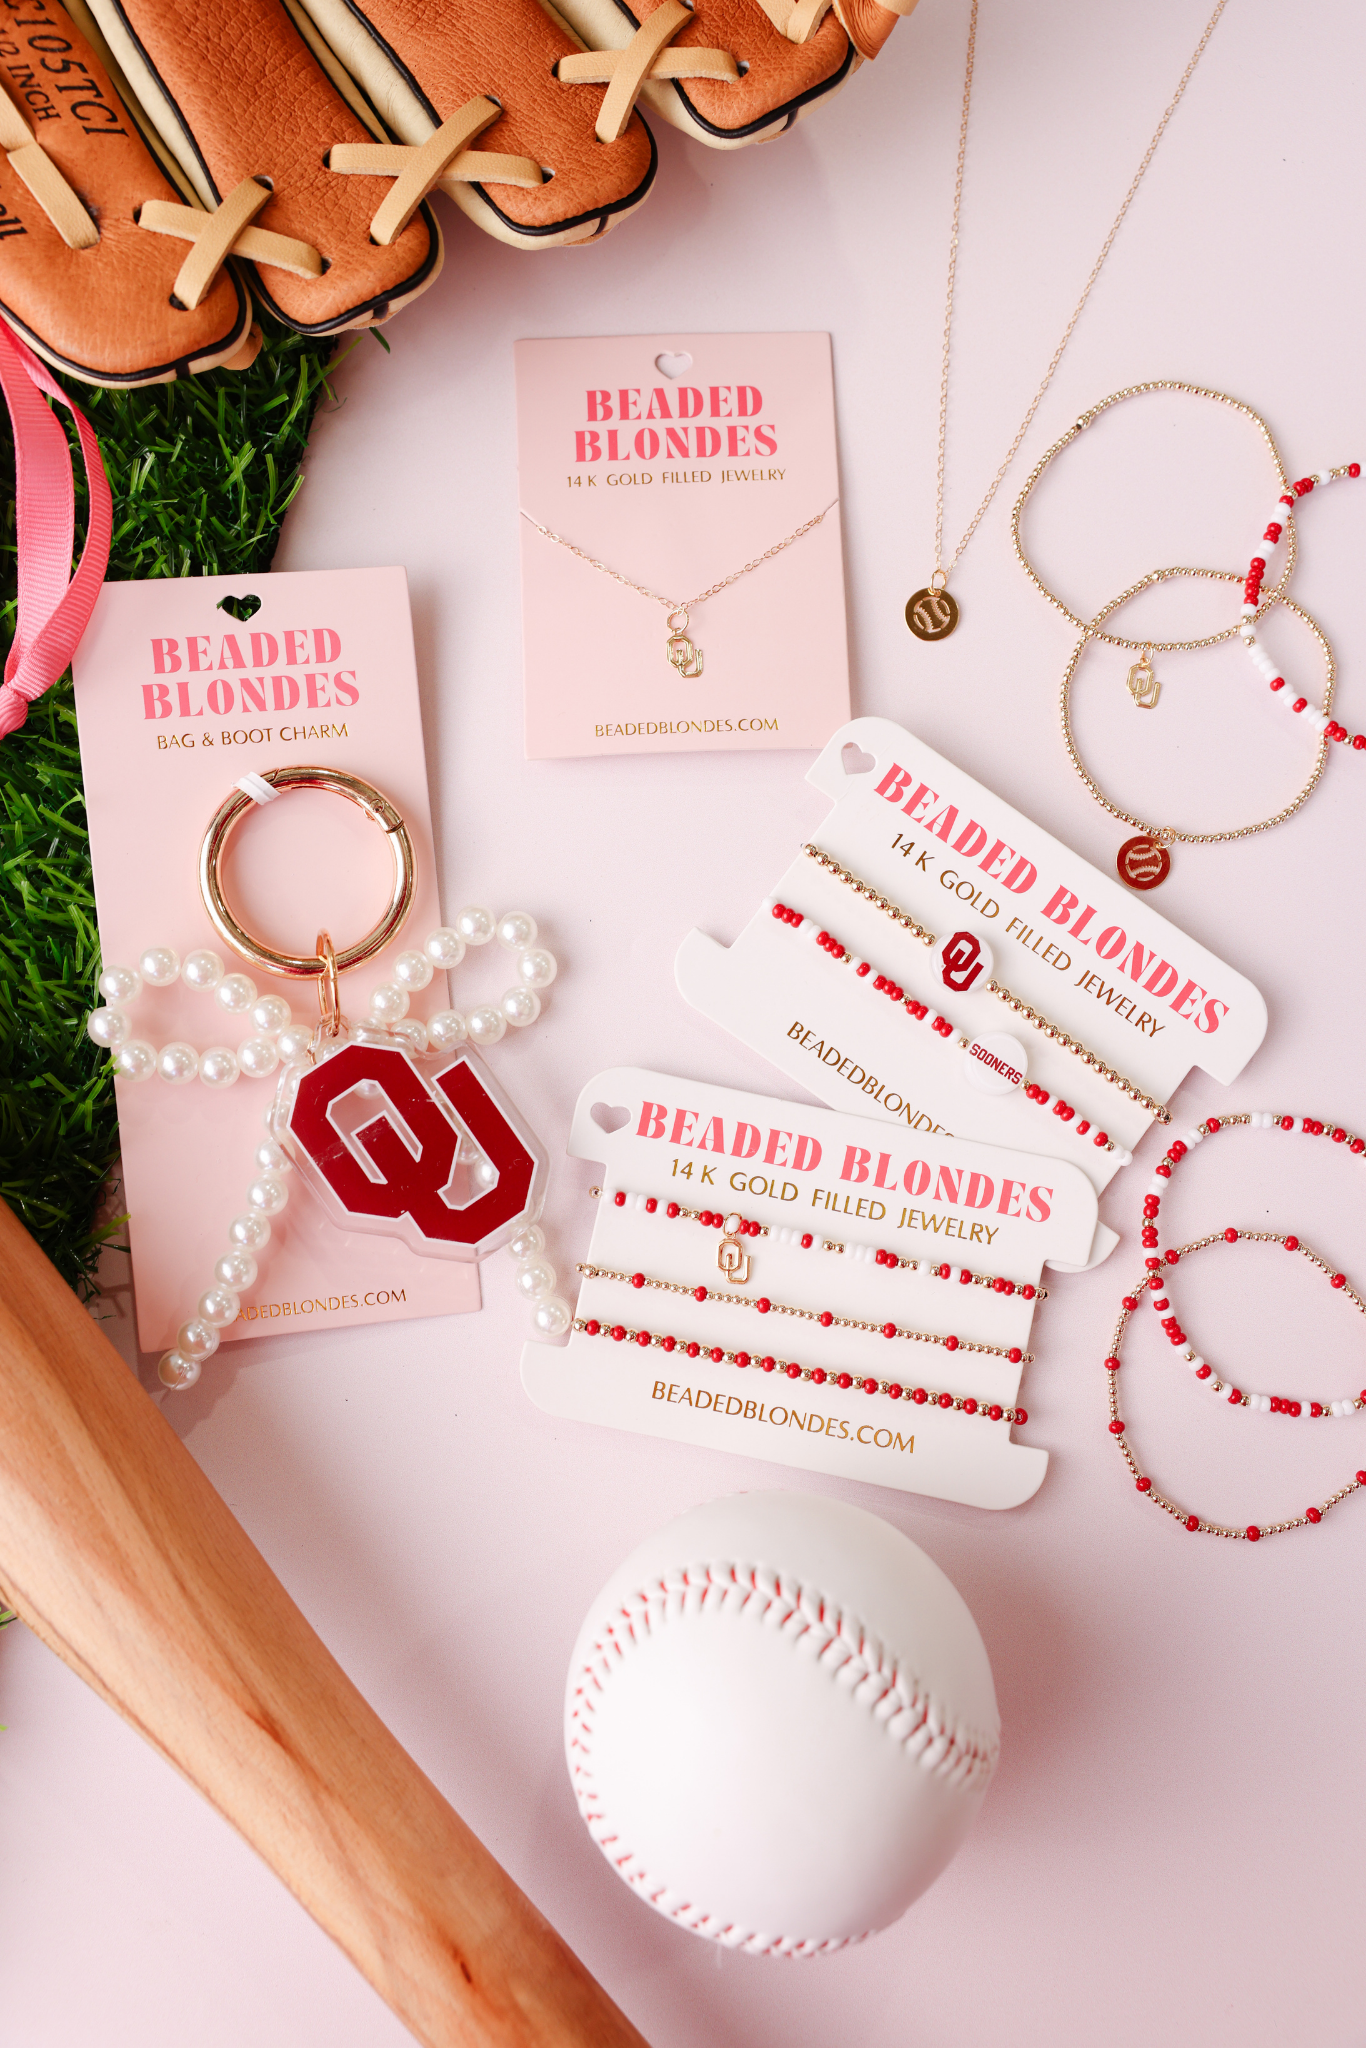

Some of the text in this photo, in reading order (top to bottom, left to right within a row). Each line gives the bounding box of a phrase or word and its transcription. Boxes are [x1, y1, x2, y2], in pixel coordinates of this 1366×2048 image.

[6, 63, 62, 122] INCH
[586, 385, 763, 423] BEADED
[574, 424, 777, 462] BLONDES
[607, 473, 652, 486] GOLD
[662, 471, 711, 483] FILLED
[721, 469, 786, 483] JEWELRY
[150, 628, 341, 674] BEADED
[141, 670, 359, 719] BLONDES
[157, 723, 349, 749] BAG & BOOT CHARM
[595, 718, 779, 737] BEADEDBLONDES.COM
[873, 762, 1230, 1034] BEADED BLONDES
[940, 870, 999, 918] GOLD
[1005, 917, 1071, 971] FILLED
[1074, 970, 1166, 1037] JEWELRY
[969, 1043, 1024, 1085] SOONERS
[635, 1101, 1053, 1222] BEADED BLONDES
[730, 1169, 798, 1201] GOLD
[812, 1187, 887, 1220] FILLED
[897, 1207, 999, 1245] JEWELRY
[234, 1289, 408, 1322] ADEDBLONDES.COM
[652, 1381, 914, 1453] BEADEDBLONDES.COM
